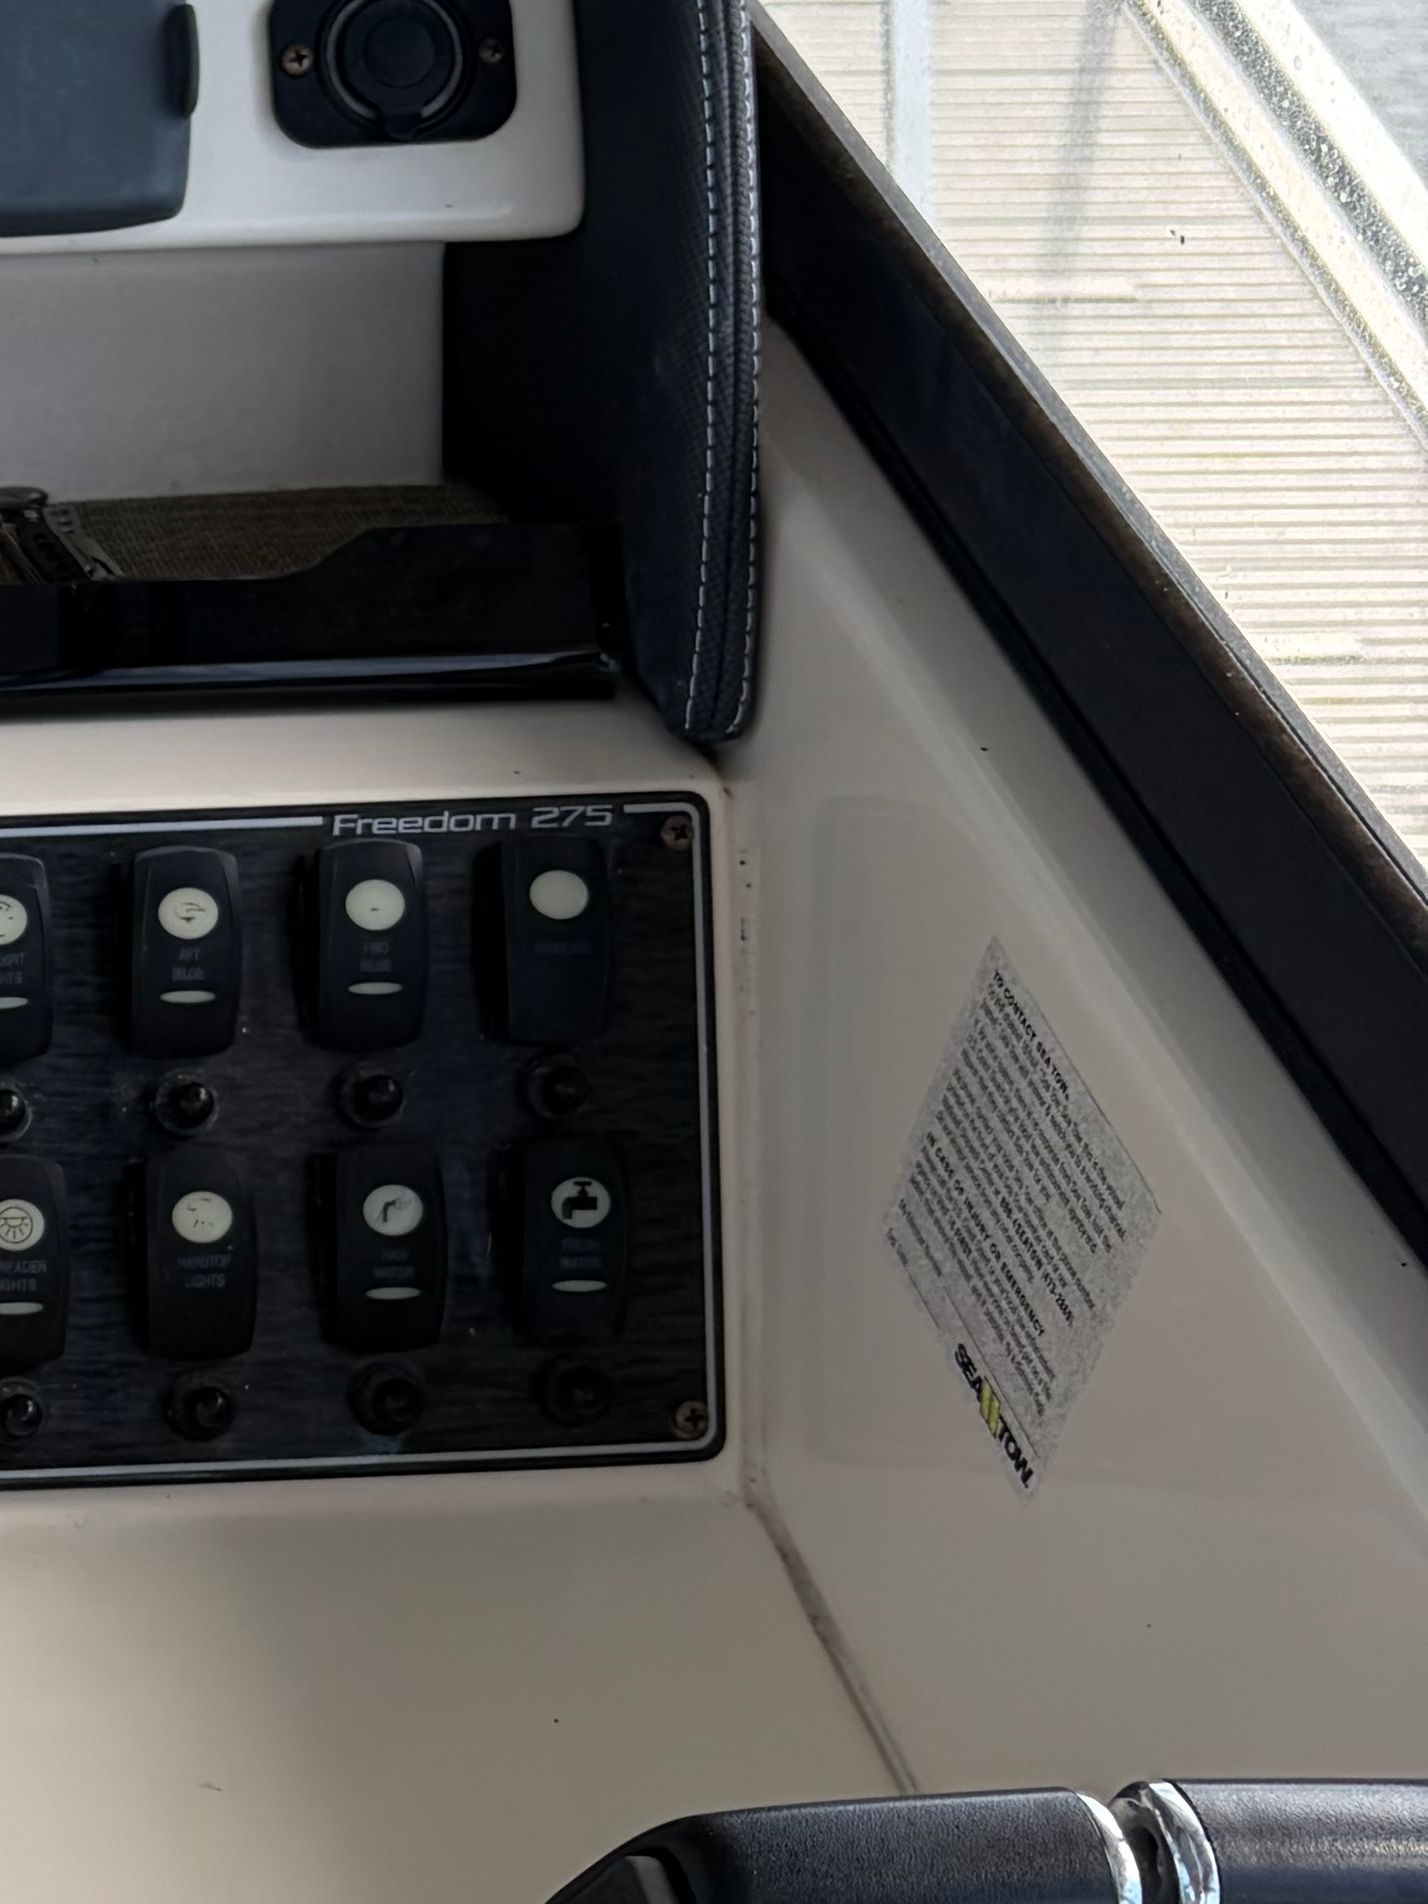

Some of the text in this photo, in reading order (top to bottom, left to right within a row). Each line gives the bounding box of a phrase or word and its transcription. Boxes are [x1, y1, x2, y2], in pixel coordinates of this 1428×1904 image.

[332, 805, 614, 836] Freedom 275
[955, 1343, 982, 1403] SEA
